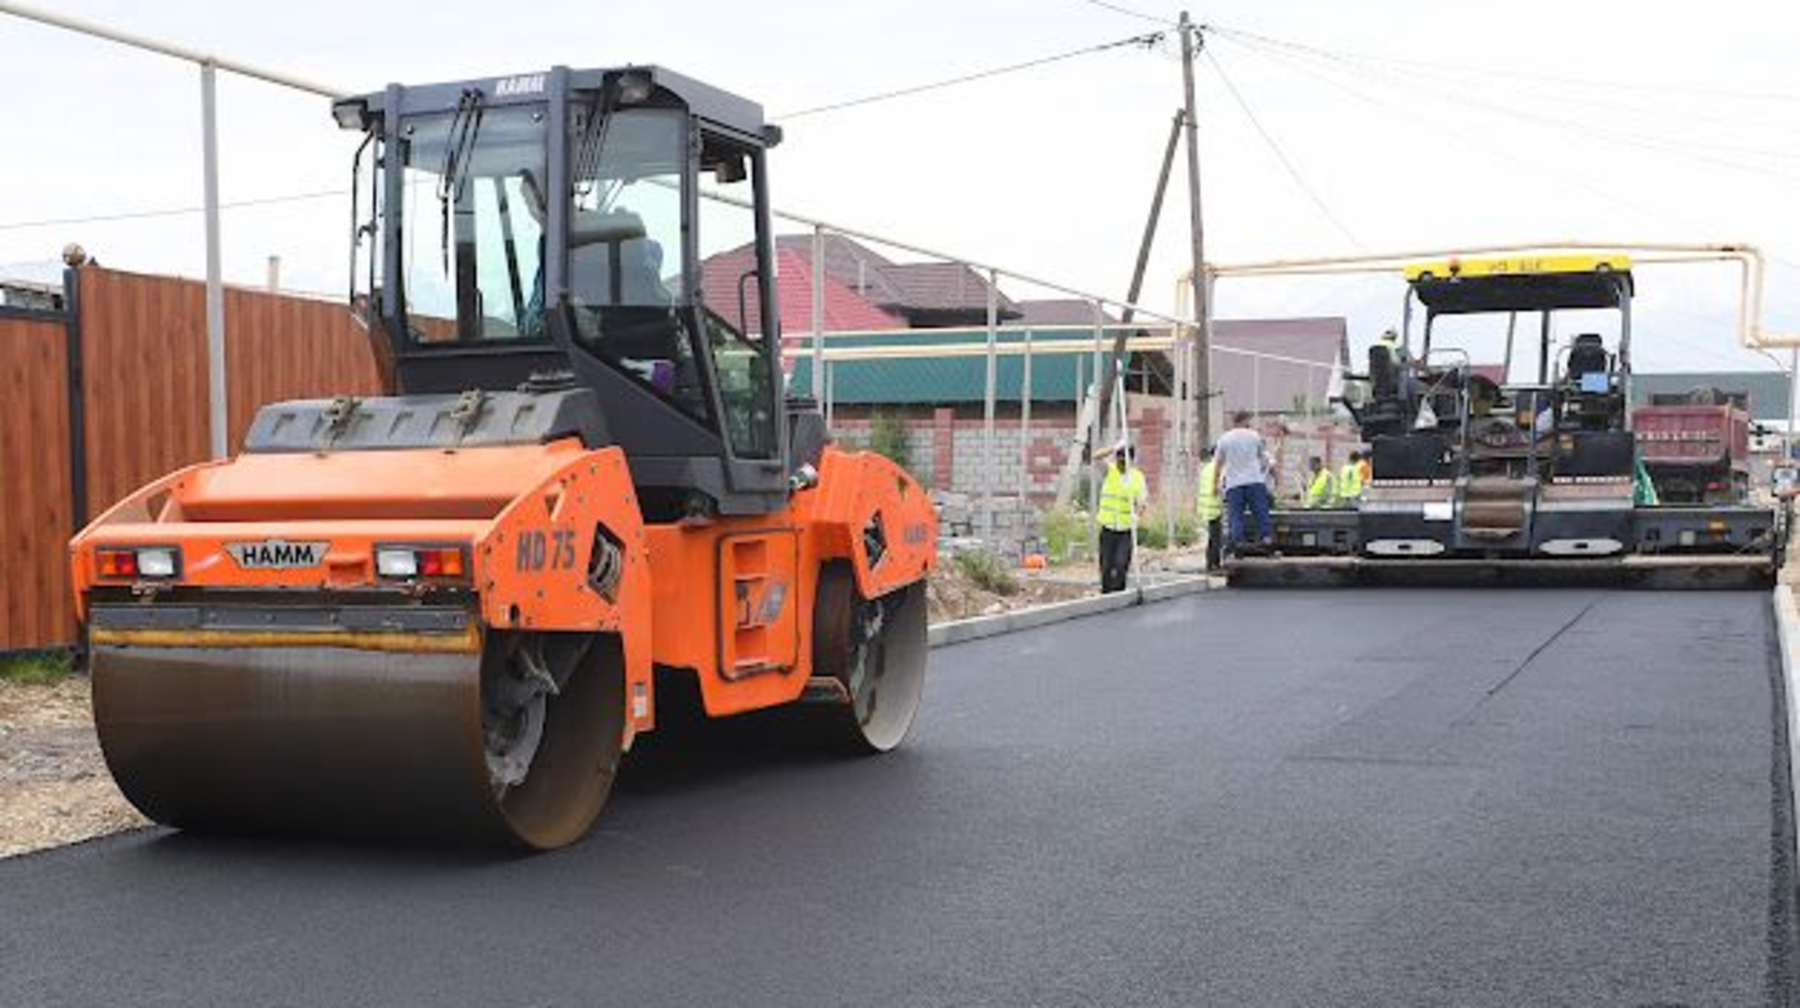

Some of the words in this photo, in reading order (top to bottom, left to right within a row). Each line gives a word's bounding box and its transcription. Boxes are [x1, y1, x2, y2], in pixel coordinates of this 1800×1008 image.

[242, 546, 315, 567] HAMM
[515, 530, 546, 572] HD
[551, 529, 575, 571] 75
